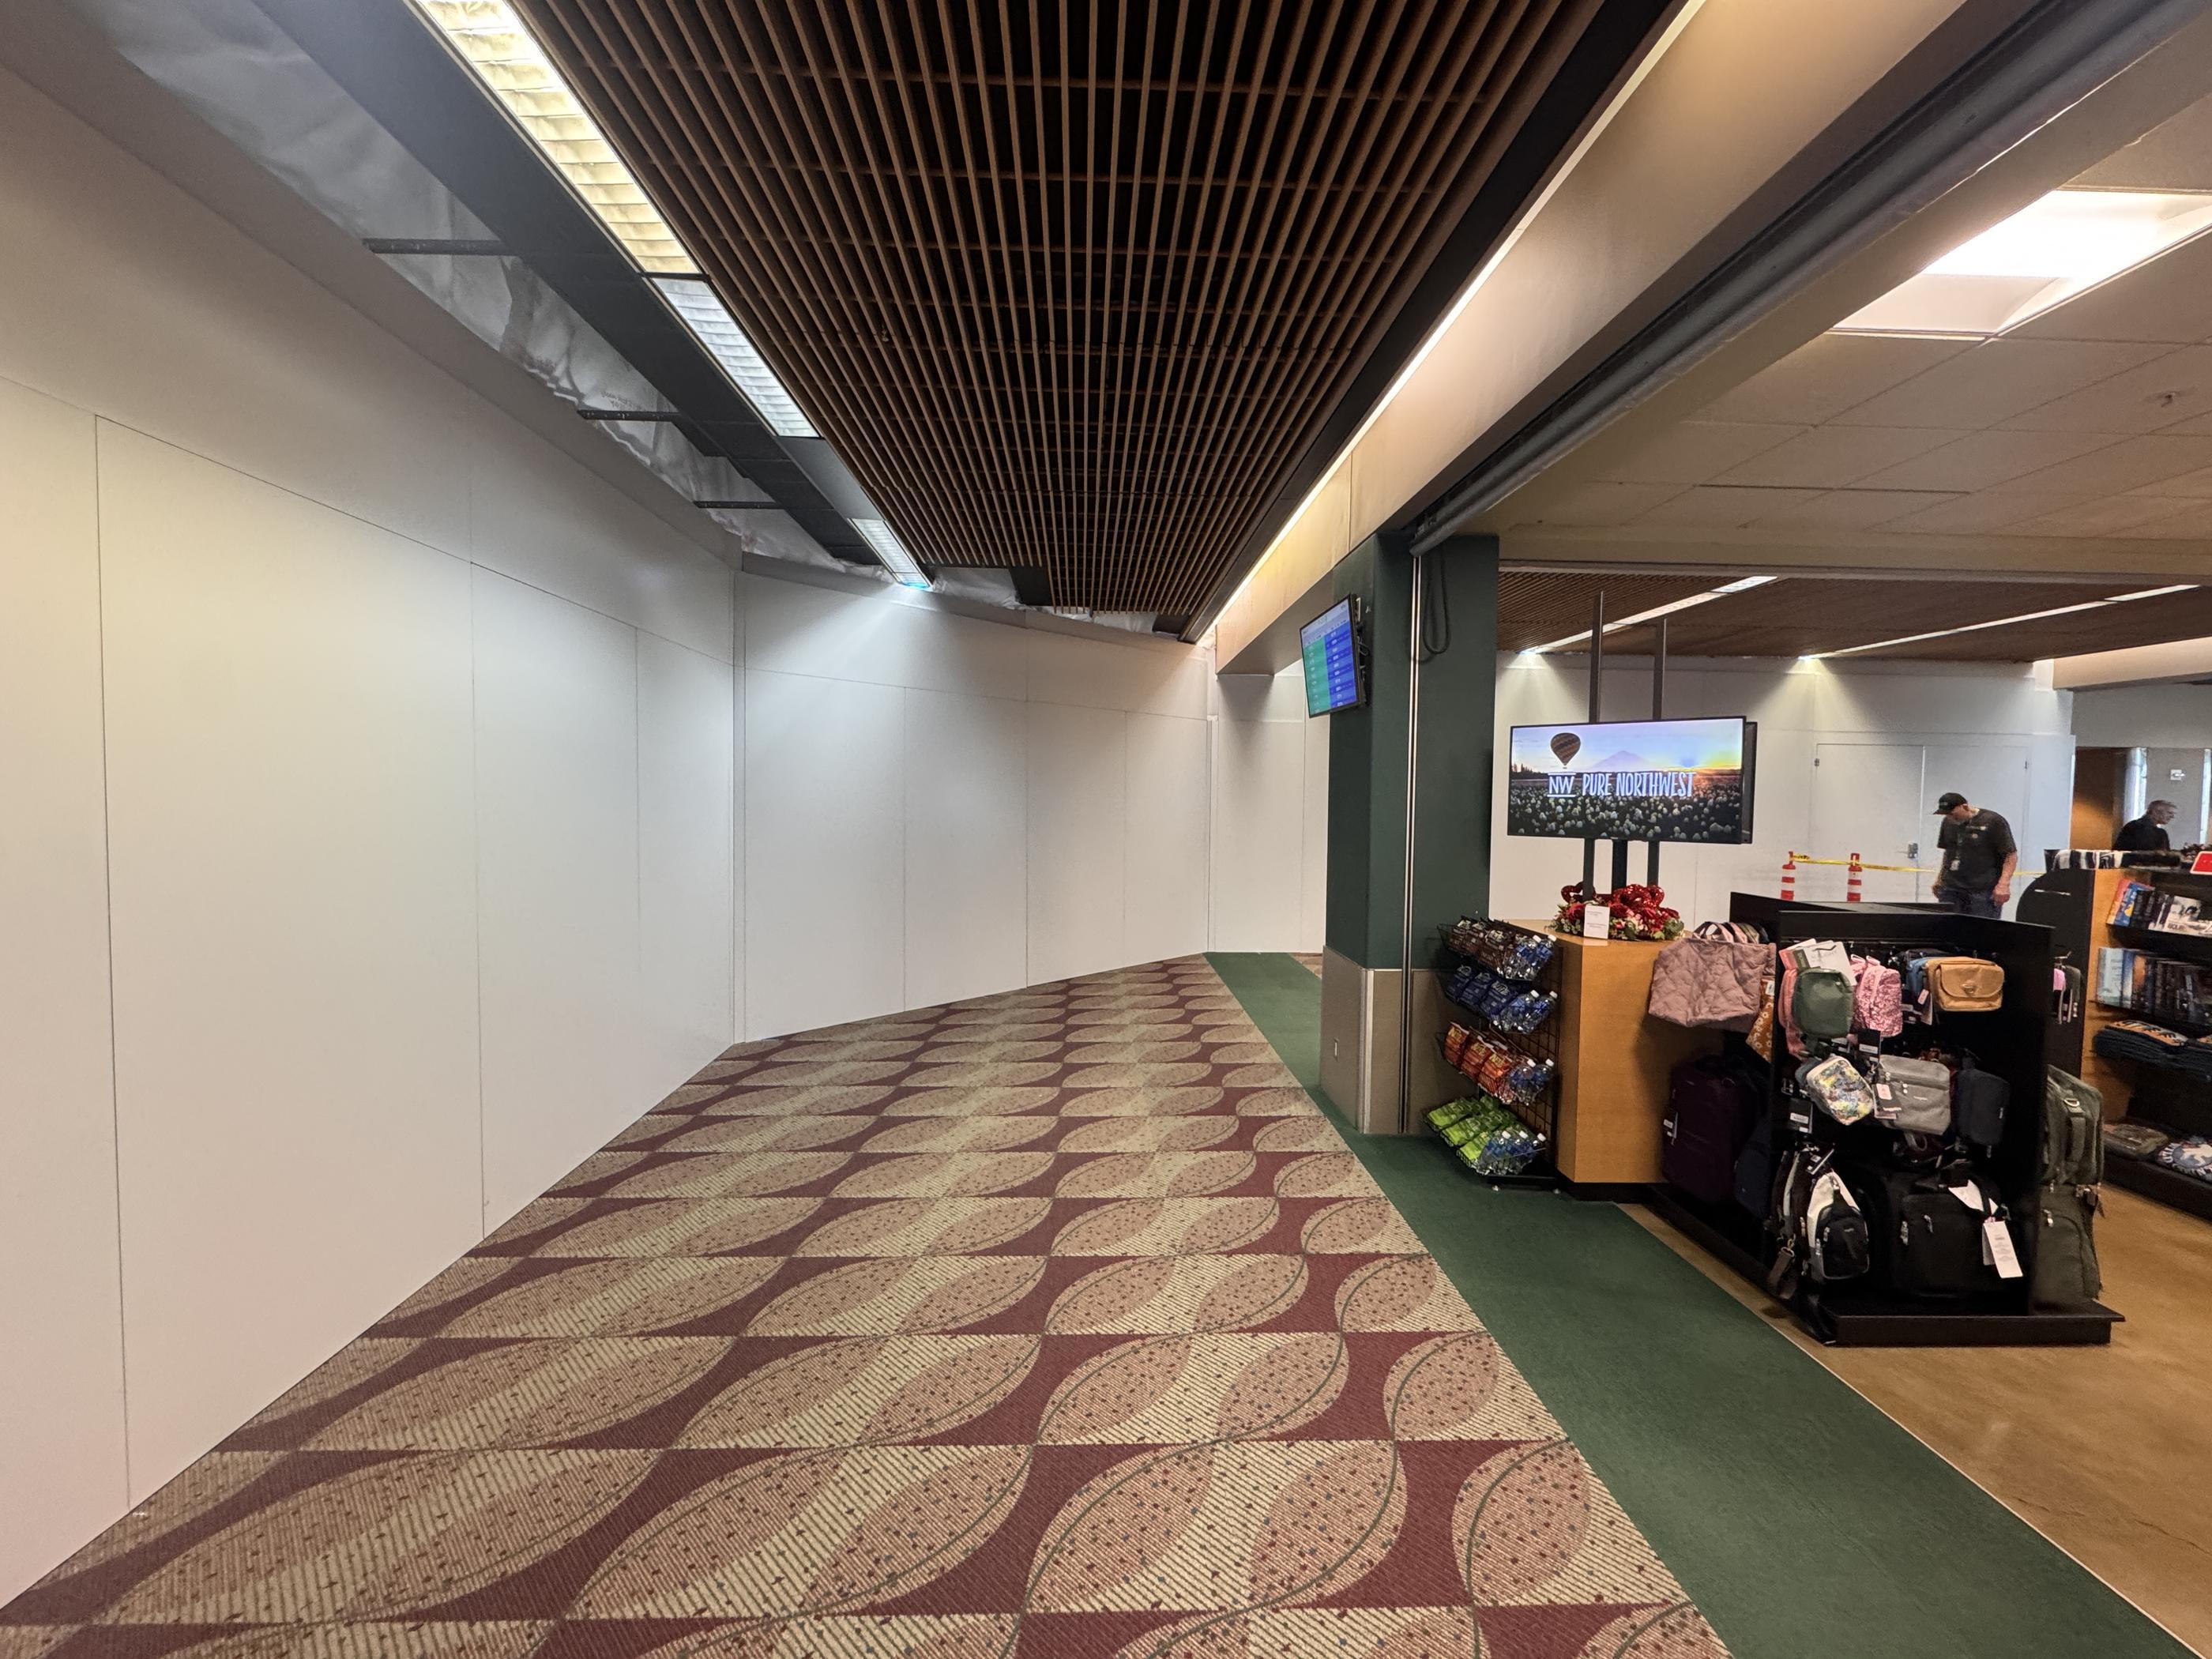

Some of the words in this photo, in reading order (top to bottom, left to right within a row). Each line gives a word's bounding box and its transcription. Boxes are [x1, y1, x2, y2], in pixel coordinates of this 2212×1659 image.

[1548, 776, 1574, 794] NW
[1582, 773, 1612, 796] PURE
[1616, 772, 1696, 797] NORTHWEST
